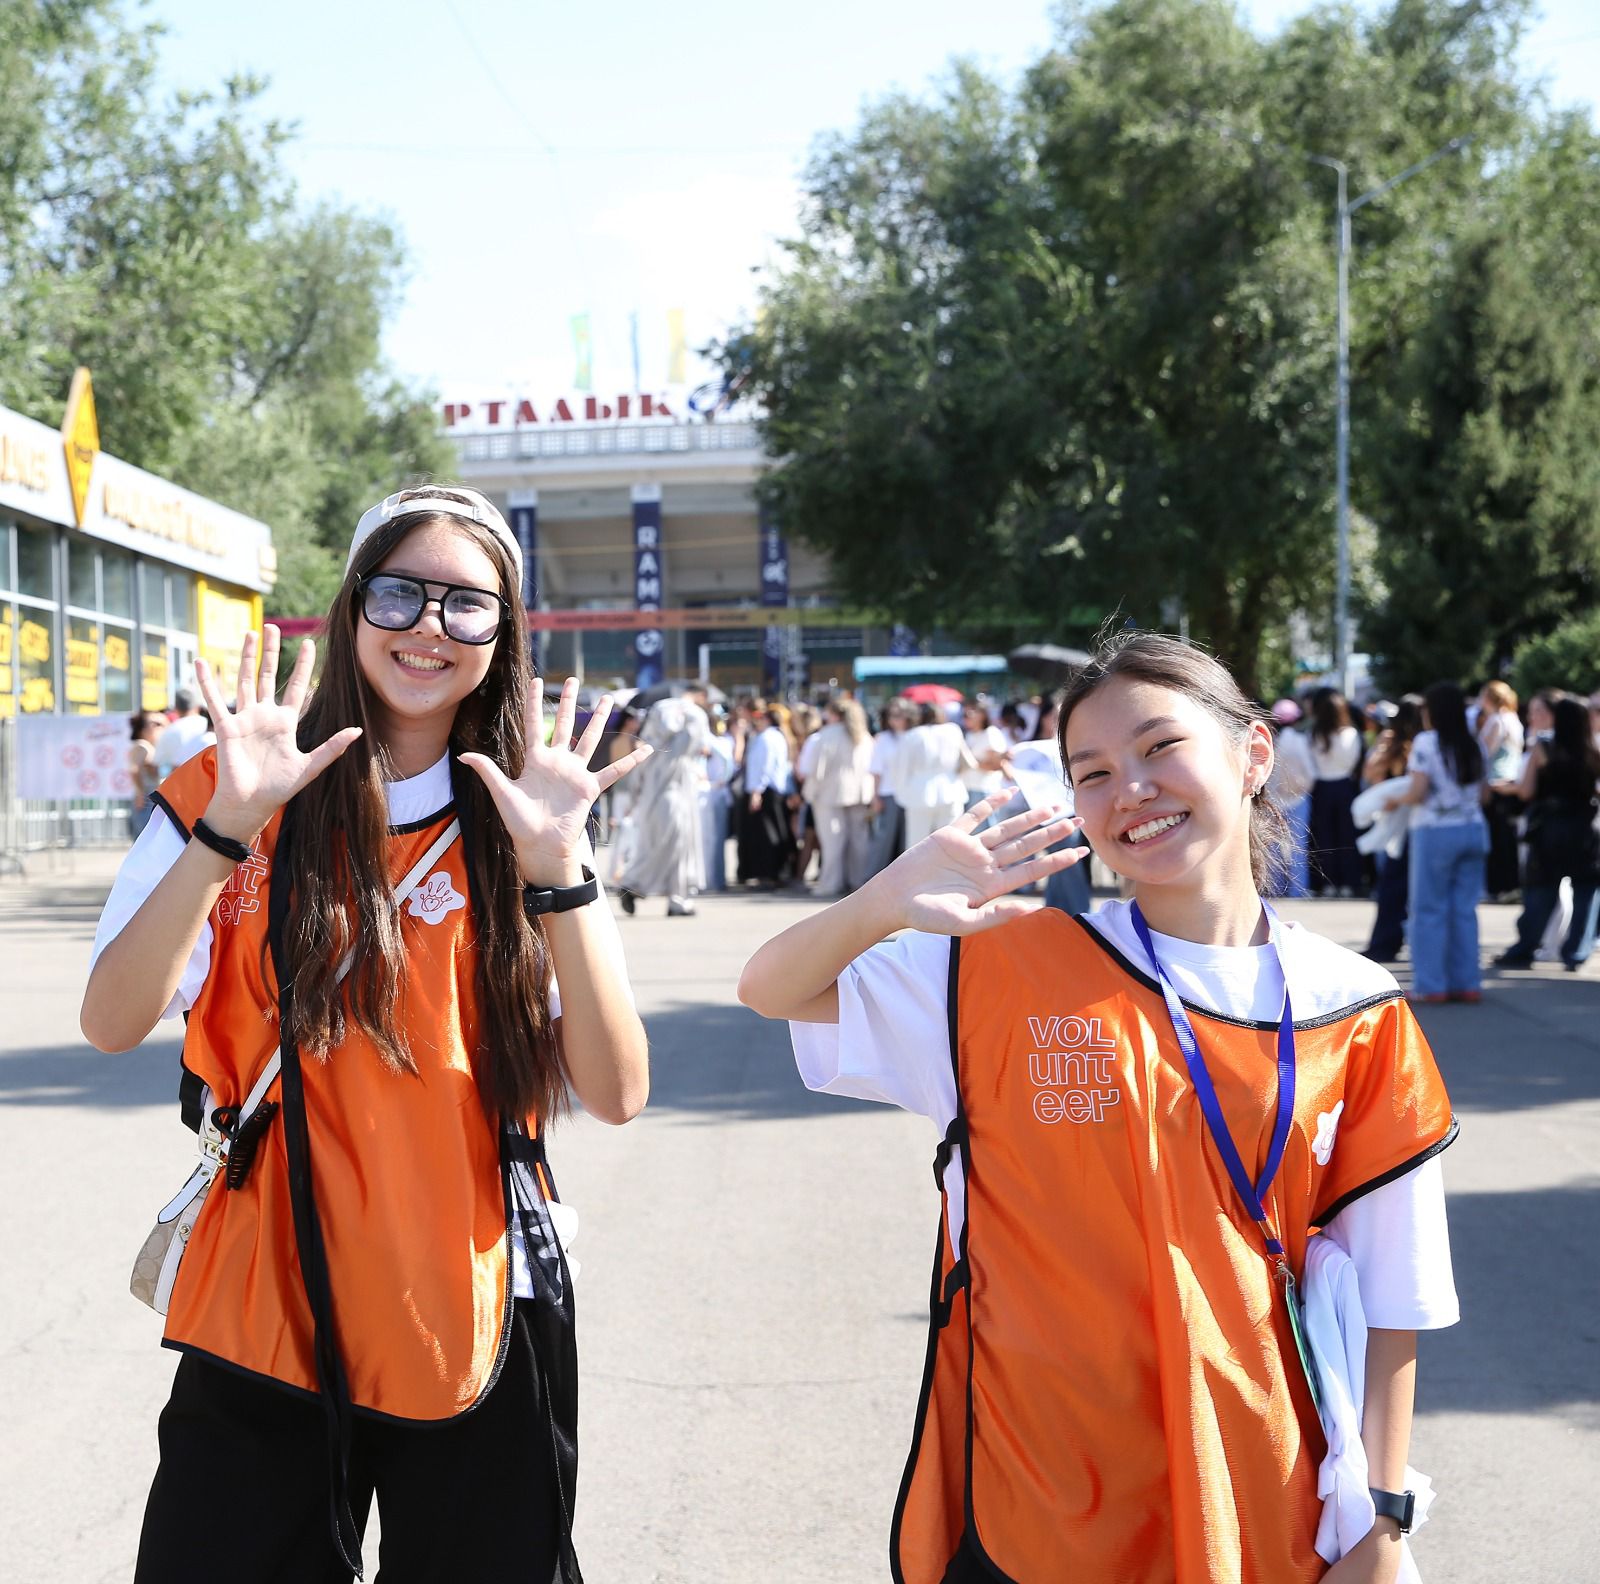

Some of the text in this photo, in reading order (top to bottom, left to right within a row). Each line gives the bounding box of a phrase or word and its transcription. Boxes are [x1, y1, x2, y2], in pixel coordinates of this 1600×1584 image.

[1027, 1015, 1116, 1048] VOL
[1028, 1051, 1116, 1087] unt
[1032, 1089, 1120, 1124] eer
